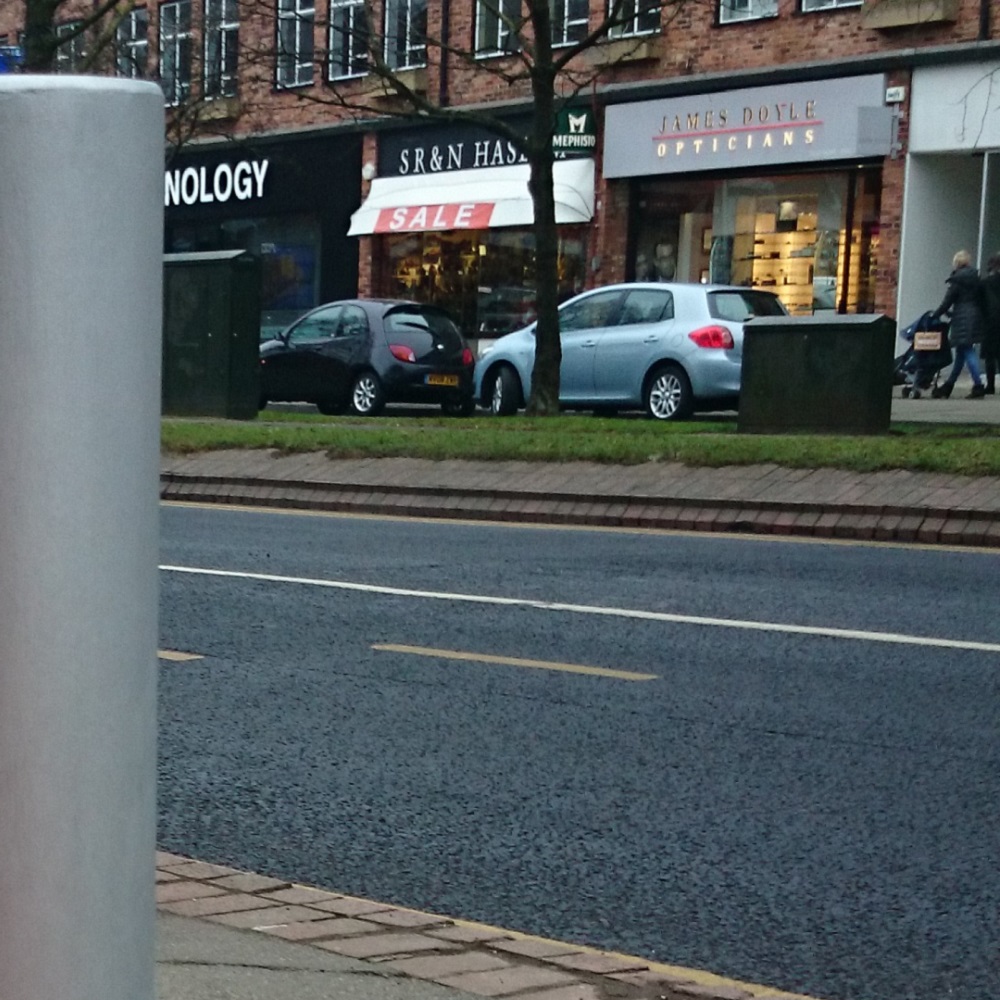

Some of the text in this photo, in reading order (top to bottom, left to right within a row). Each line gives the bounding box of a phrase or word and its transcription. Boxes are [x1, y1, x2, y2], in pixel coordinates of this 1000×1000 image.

[659, 99, 816, 135] JAMES DOYLE
[552, 134, 596, 147] MEPHISTO
[656, 129, 815, 157] OPTICIANS
[388, 204, 476, 230] SALE
